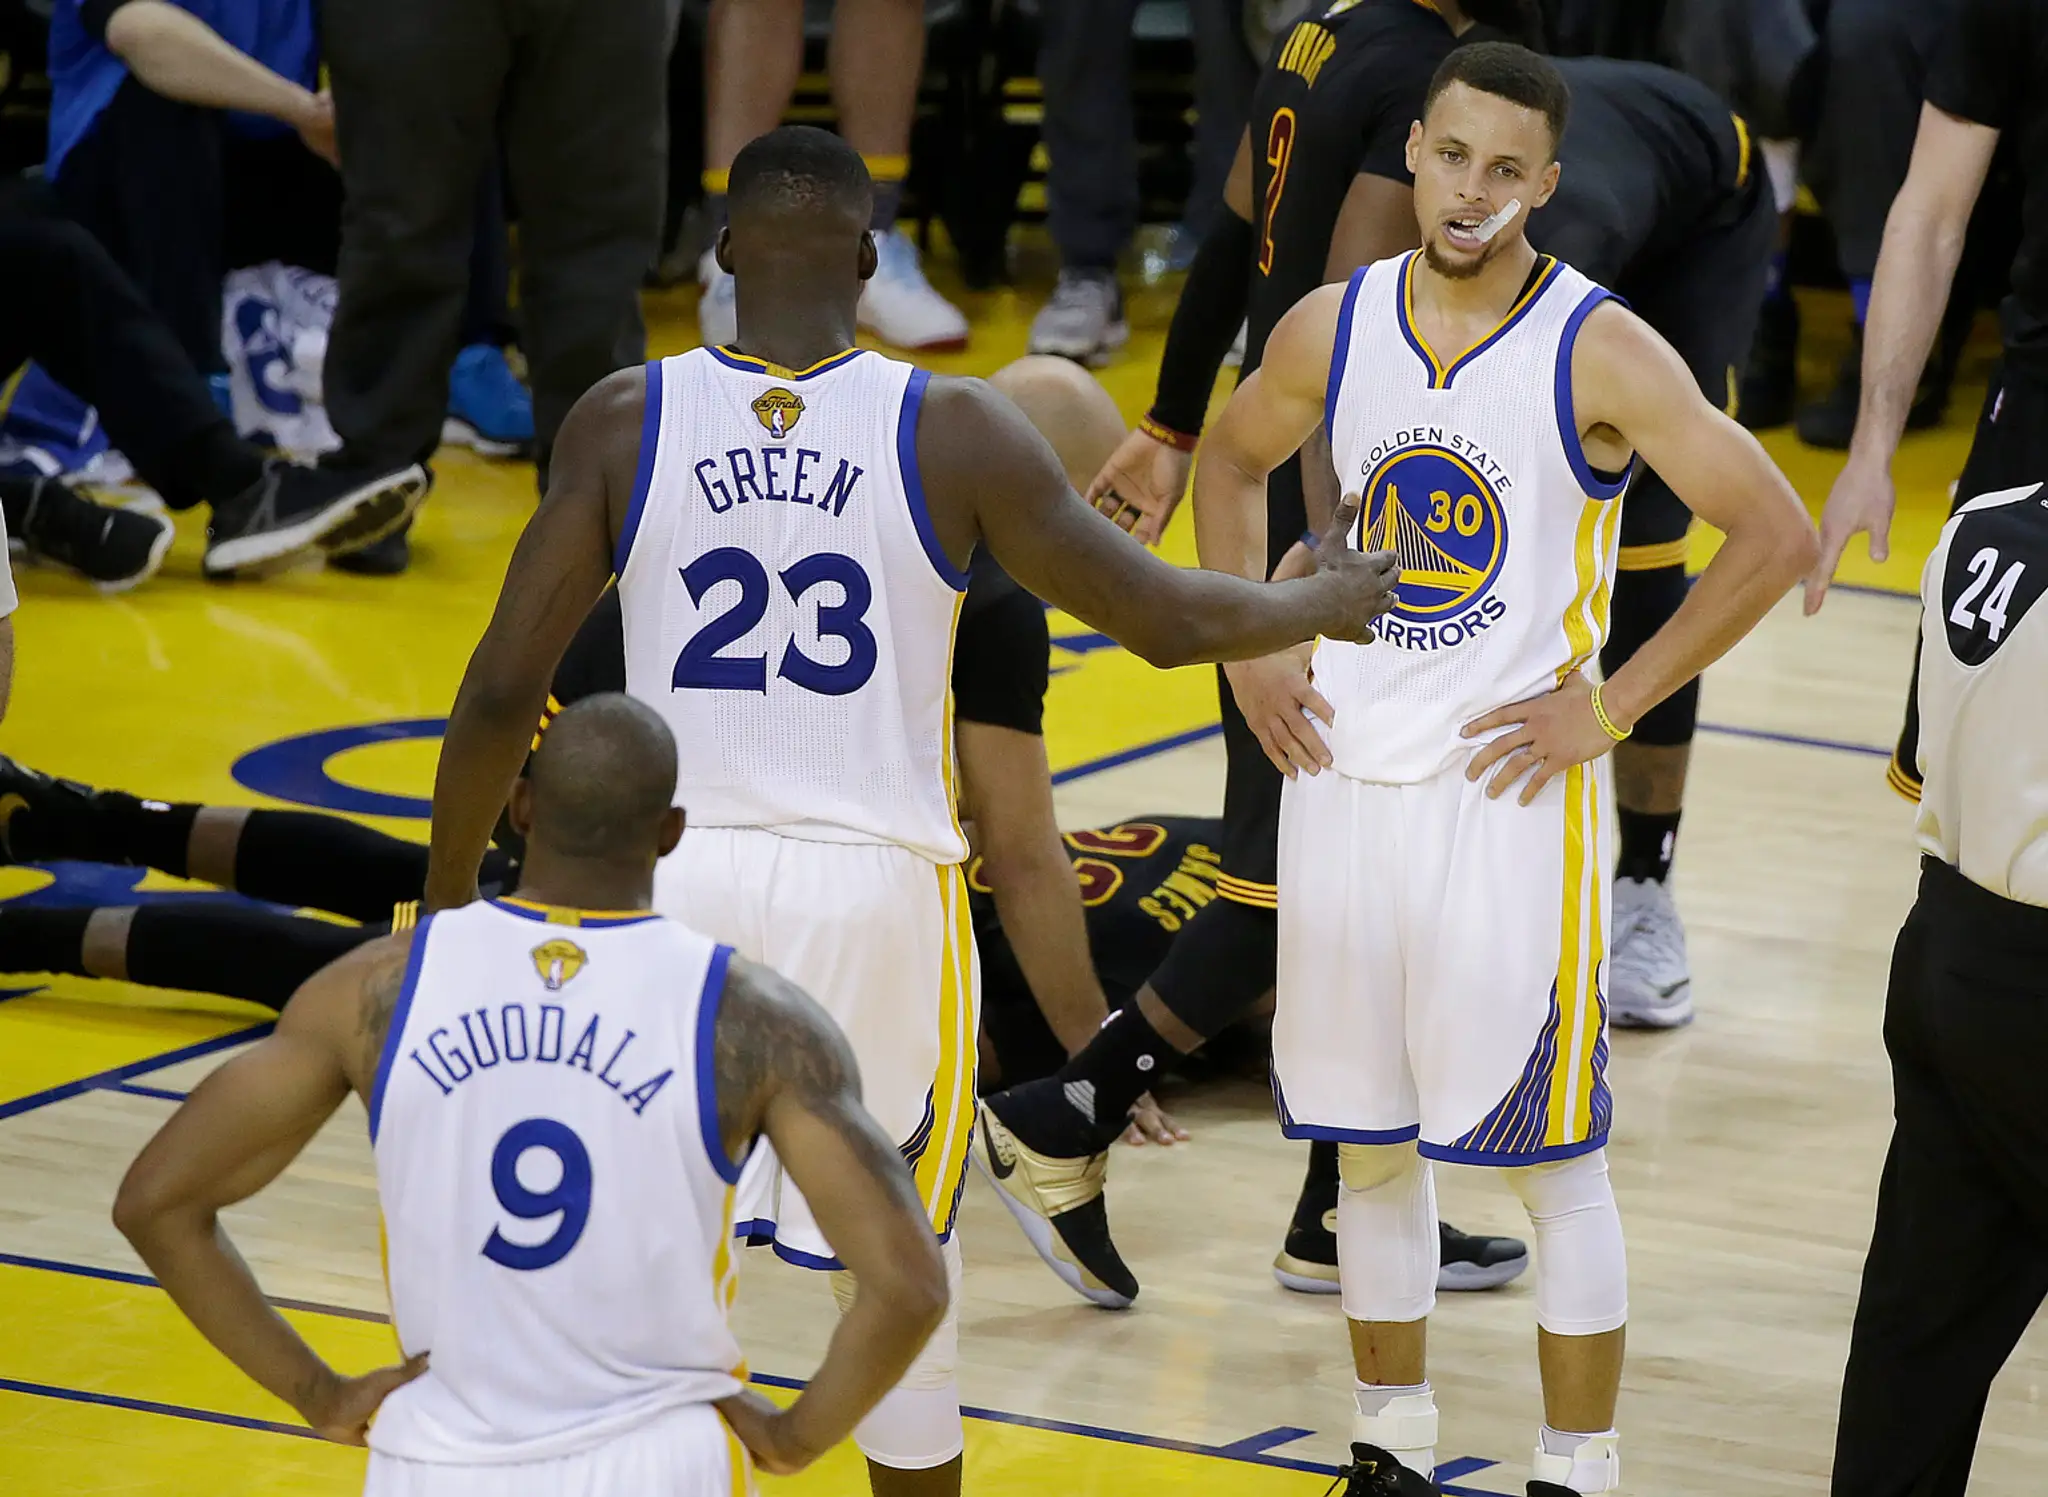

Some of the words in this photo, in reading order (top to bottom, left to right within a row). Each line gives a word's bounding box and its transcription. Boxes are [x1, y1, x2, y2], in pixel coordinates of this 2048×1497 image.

[1259, 107, 1296, 277] 2
[694, 447, 865, 518] GREEN
[1361, 427, 1443, 477] GOLDEN
[1450, 434, 1512, 493] STATE
[1424, 490, 1484, 537] 30
[671, 546, 878, 696] 23
[1367, 594, 1508, 651] ARRIORS
[1950, 546, 2027, 643] 24
[409, 1003, 675, 1117] IGUODALA
[480, 1117, 593, 1272] 9
